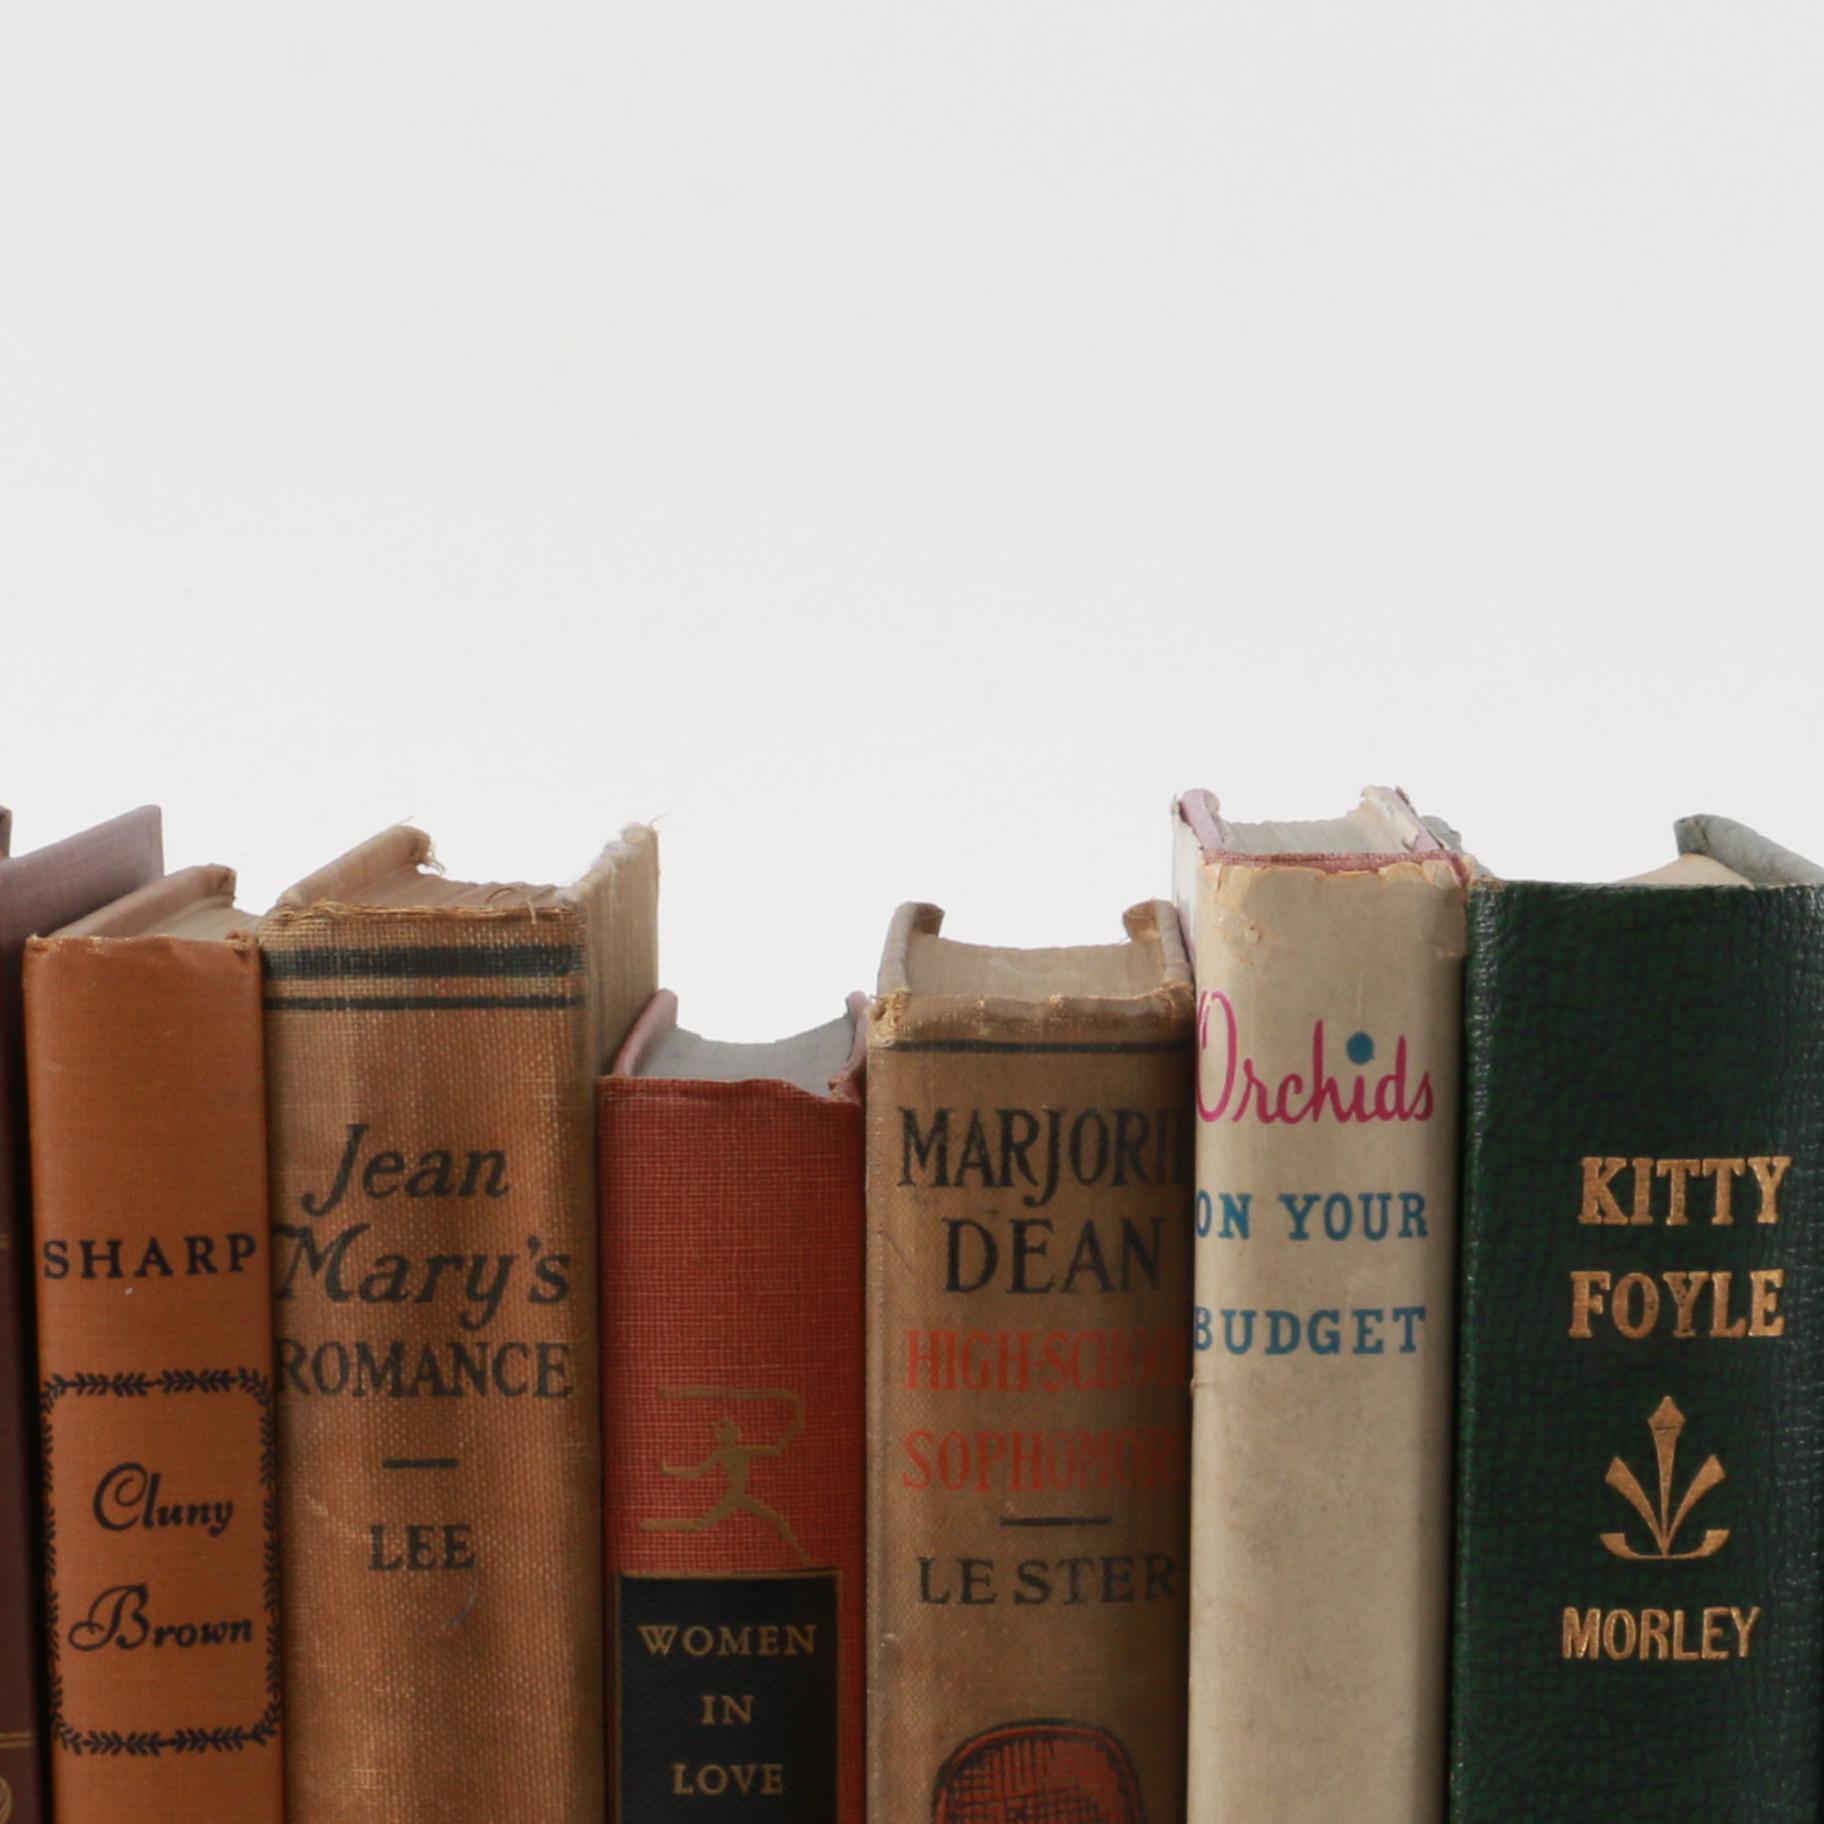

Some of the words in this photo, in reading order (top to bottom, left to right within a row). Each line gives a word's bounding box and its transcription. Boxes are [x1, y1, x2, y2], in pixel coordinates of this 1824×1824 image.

[1195, 990, 1434, 1124] Orchids
[301, 1123, 510, 1217] Jean
[1578, 1156, 1791, 1225] KITTY
[1195, 1189, 1252, 1240] ON
[1279, 1192, 1429, 1240] YOUR
[43, 1233, 257, 1280] SHARP
[272, 1223, 572, 1331] Mary's
[943, 1217, 1164, 1295] DEAN
[1193, 1306, 1426, 1355] BUDGET
[1568, 1269, 1784, 1338] FOYLE
[277, 1339, 573, 1399] ROMANCE
[92, 1462, 234, 1537] Cluny
[368, 1524, 475, 1571] LEE
[917, 1554, 1176, 1606] LESTER
[68, 1584, 253, 1652] Brown
[638, 1625, 817, 1656] WOMEN
[1562, 1607, 1760, 1661] MORLEY
[701, 1695, 753, 1725] IN
[672, 1764, 783, 1795] LOVE
